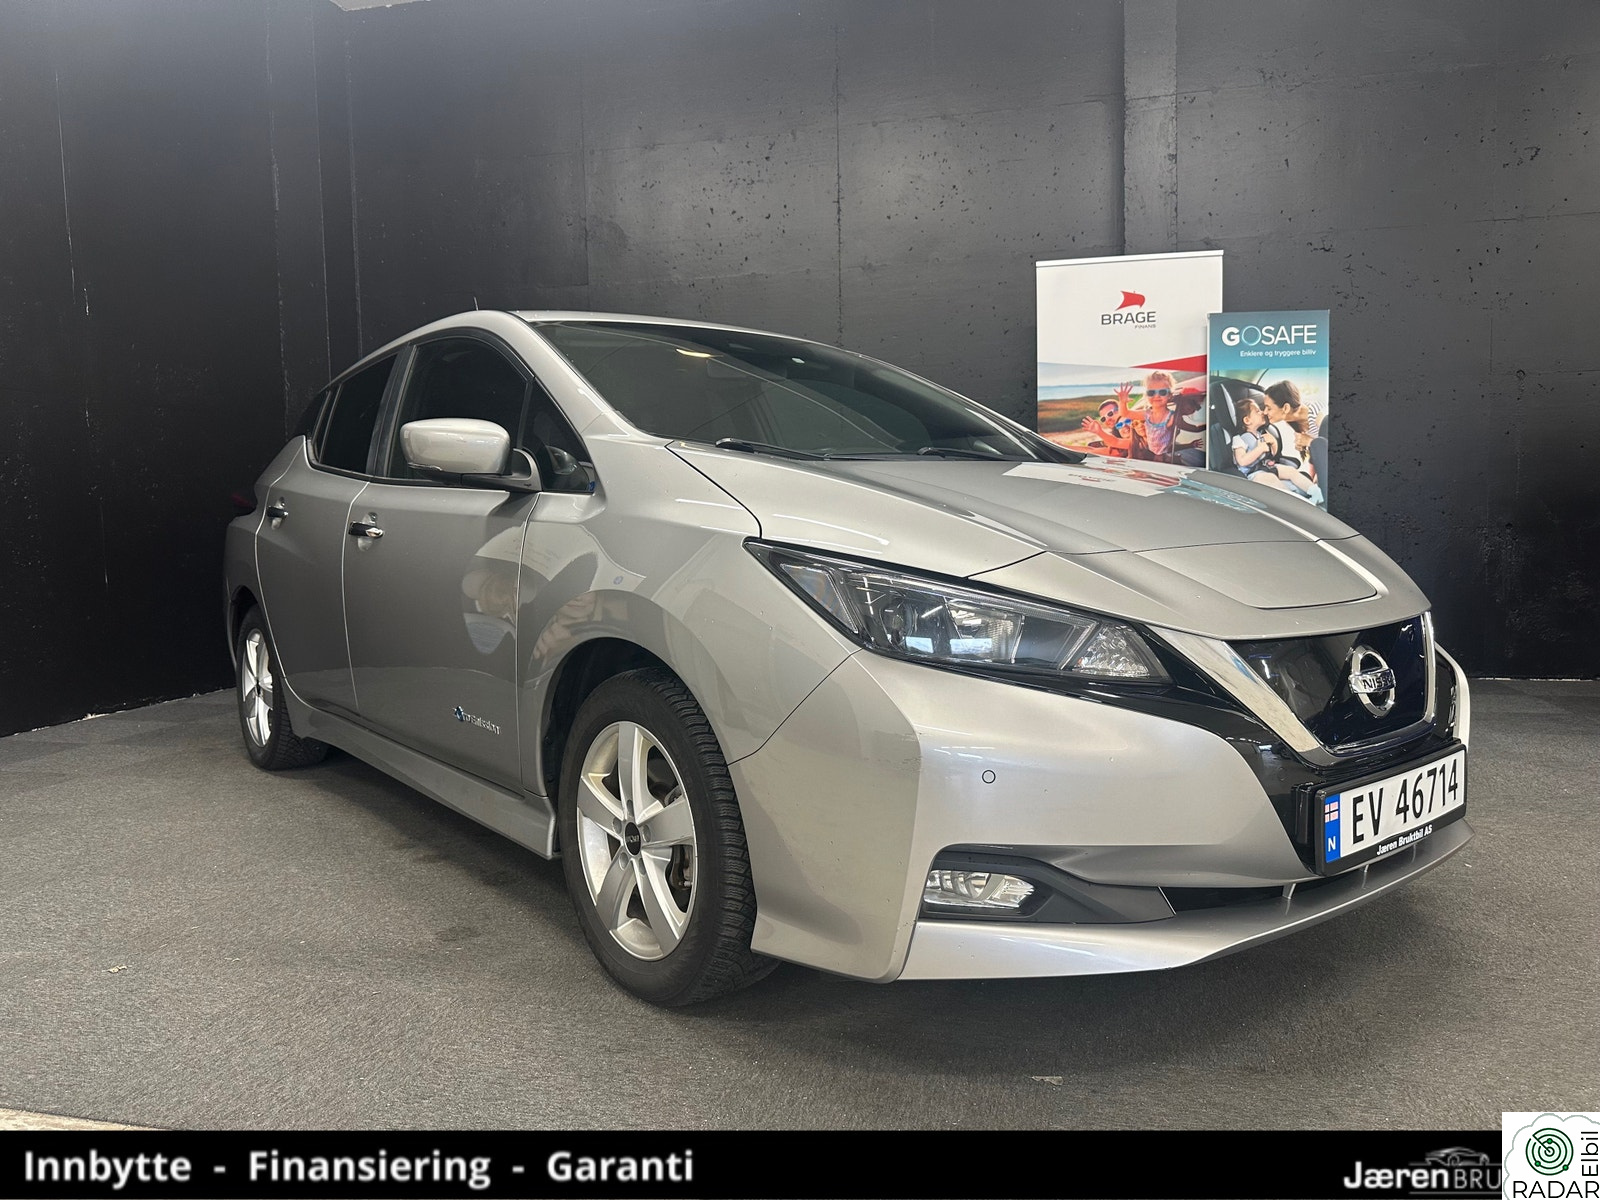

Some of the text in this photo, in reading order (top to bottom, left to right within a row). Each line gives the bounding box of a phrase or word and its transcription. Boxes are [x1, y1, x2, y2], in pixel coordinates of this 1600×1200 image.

[1101, 311, 1157, 325] BRAGE
[1221, 324, 1318, 347] GOSAFE
[1239, 348, 1317, 358] Enklere og tryggere billiv
[1352, 758, 1458, 845] EV 46714
[1327, 835, 1337, 853] N
[1376, 824, 1433, 856] Jæren Bruktbil AS
